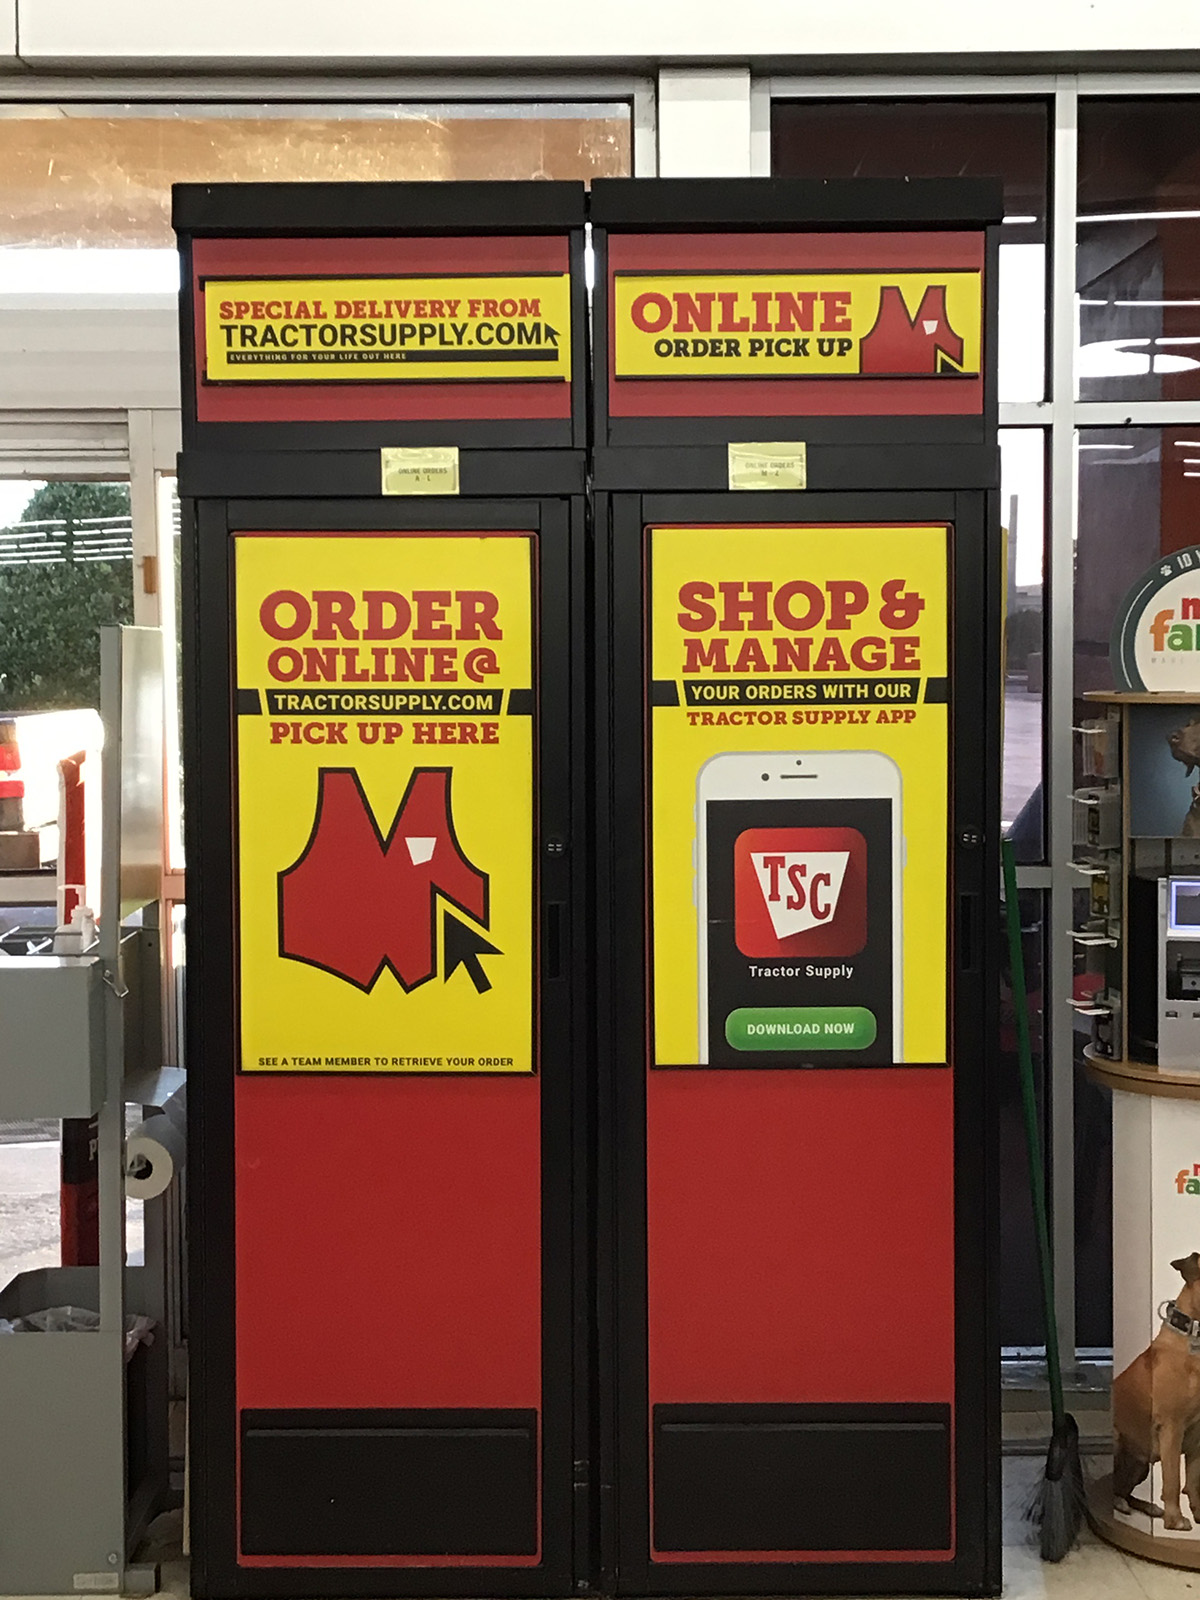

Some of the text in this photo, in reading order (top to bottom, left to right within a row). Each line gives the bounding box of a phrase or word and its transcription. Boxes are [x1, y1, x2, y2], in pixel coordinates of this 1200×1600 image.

[219, 298, 542, 320] SPECIAL DELIVERY FROM
[630, 291, 852, 334] ONLINE
[219, 322, 541, 347] TRACTORSUPPLY.COM
[230, 353, 288, 361] EVERYTHING
[290, 353, 308, 361] FOR
[312, 353, 335, 361] YOUR
[361, 352, 380, 360] OUT
[383, 352, 407, 360] HERE
[653, 337, 853, 358] ORDER PICK UP
[1176, 553, 1193, 570] ID
[259, 590, 503, 641] ORDER
[677, 579, 926, 633] SHOP &
[1149, 609, 1200, 652] fa
[682, 636, 921, 673] MANAGE
[691, 683, 912, 700] YOUR ORDERS WITH OUR
[273, 694, 493, 711] TRACTORSUPPLY.COM
[687, 709, 917, 726] TRACTOR SUPPLY APP
[269, 722, 500, 745] PICK UP HERE
[763, 856, 831, 920] TSC
[749, 964, 854, 979] Tractor Supply
[747, 1023, 855, 1036] DOWNLOAD NOW
[258, 1057, 514, 1066] SEE A TEAM MEMBER TO RETRIEVE YOUR ORDER
